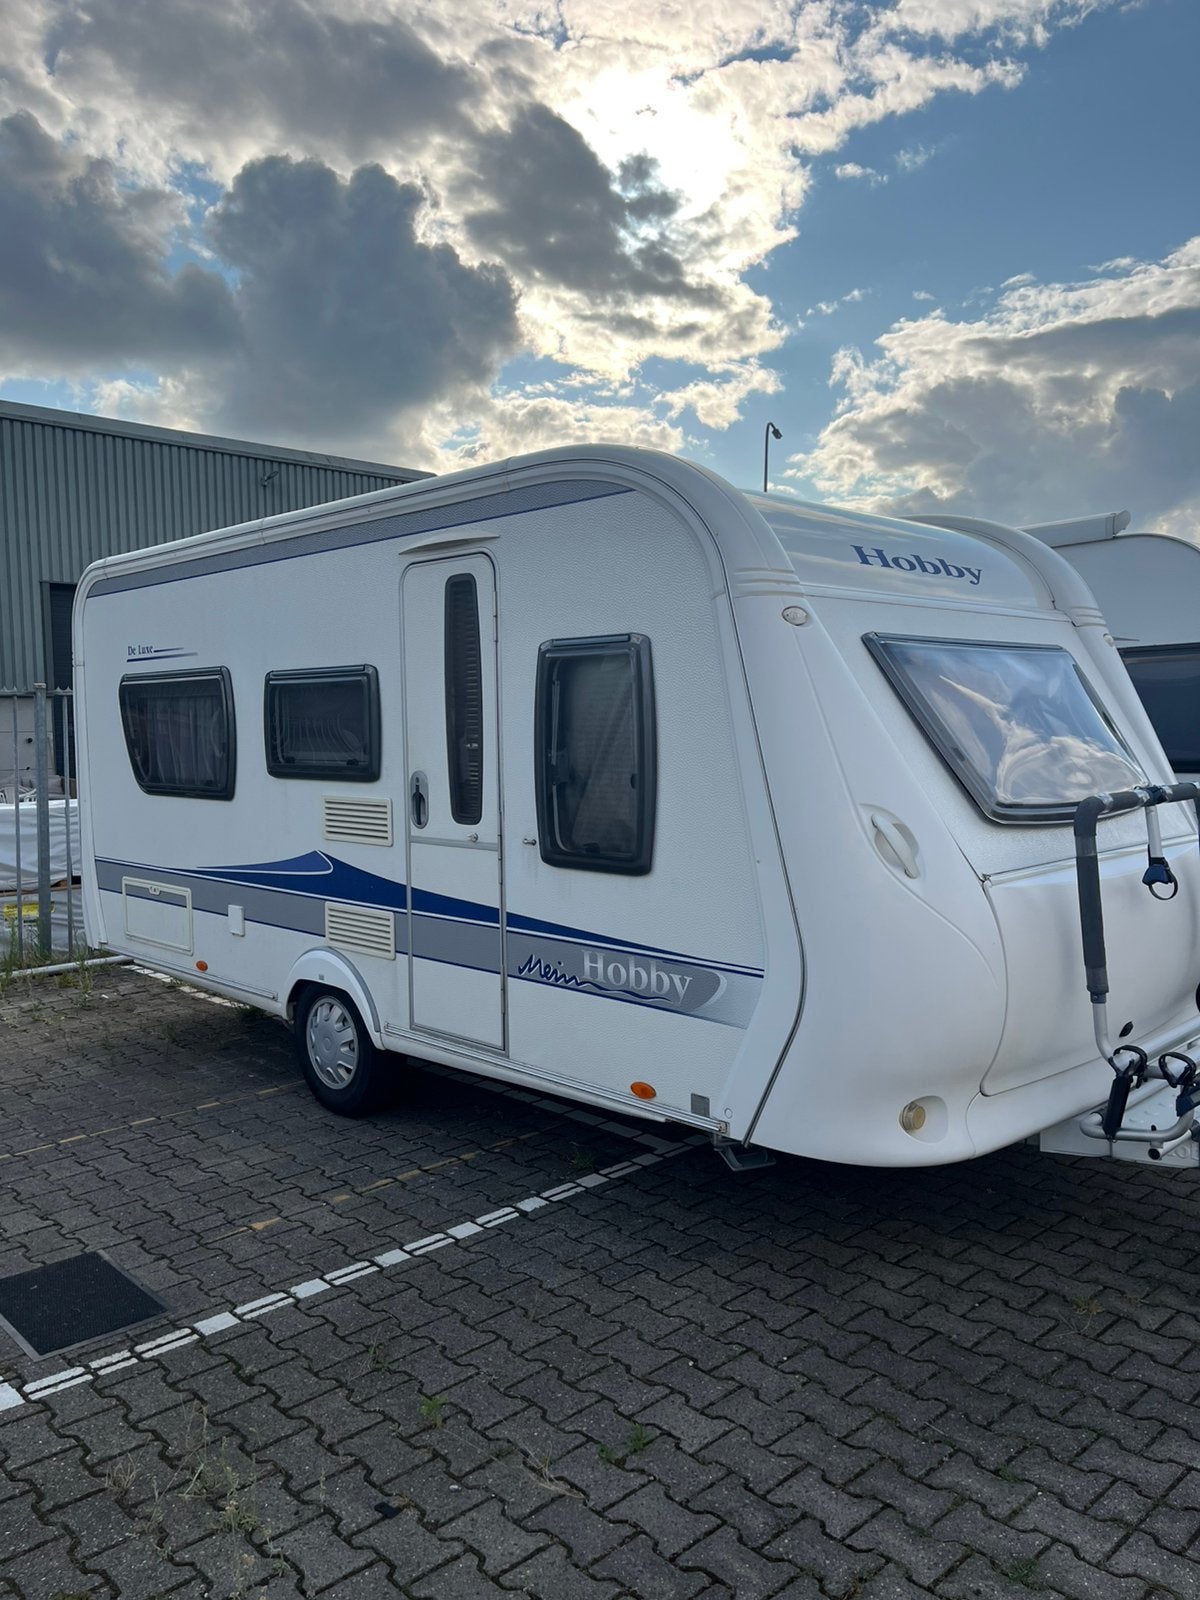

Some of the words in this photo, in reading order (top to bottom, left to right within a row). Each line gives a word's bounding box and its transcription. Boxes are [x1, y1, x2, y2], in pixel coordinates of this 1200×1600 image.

[850, 544, 983, 585] Hobby
[127, 645, 137, 656] De
[138, 644, 154, 655] Luxe
[518, 954, 588, 987] Mein
[581, 949, 693, 1005] Hobby
